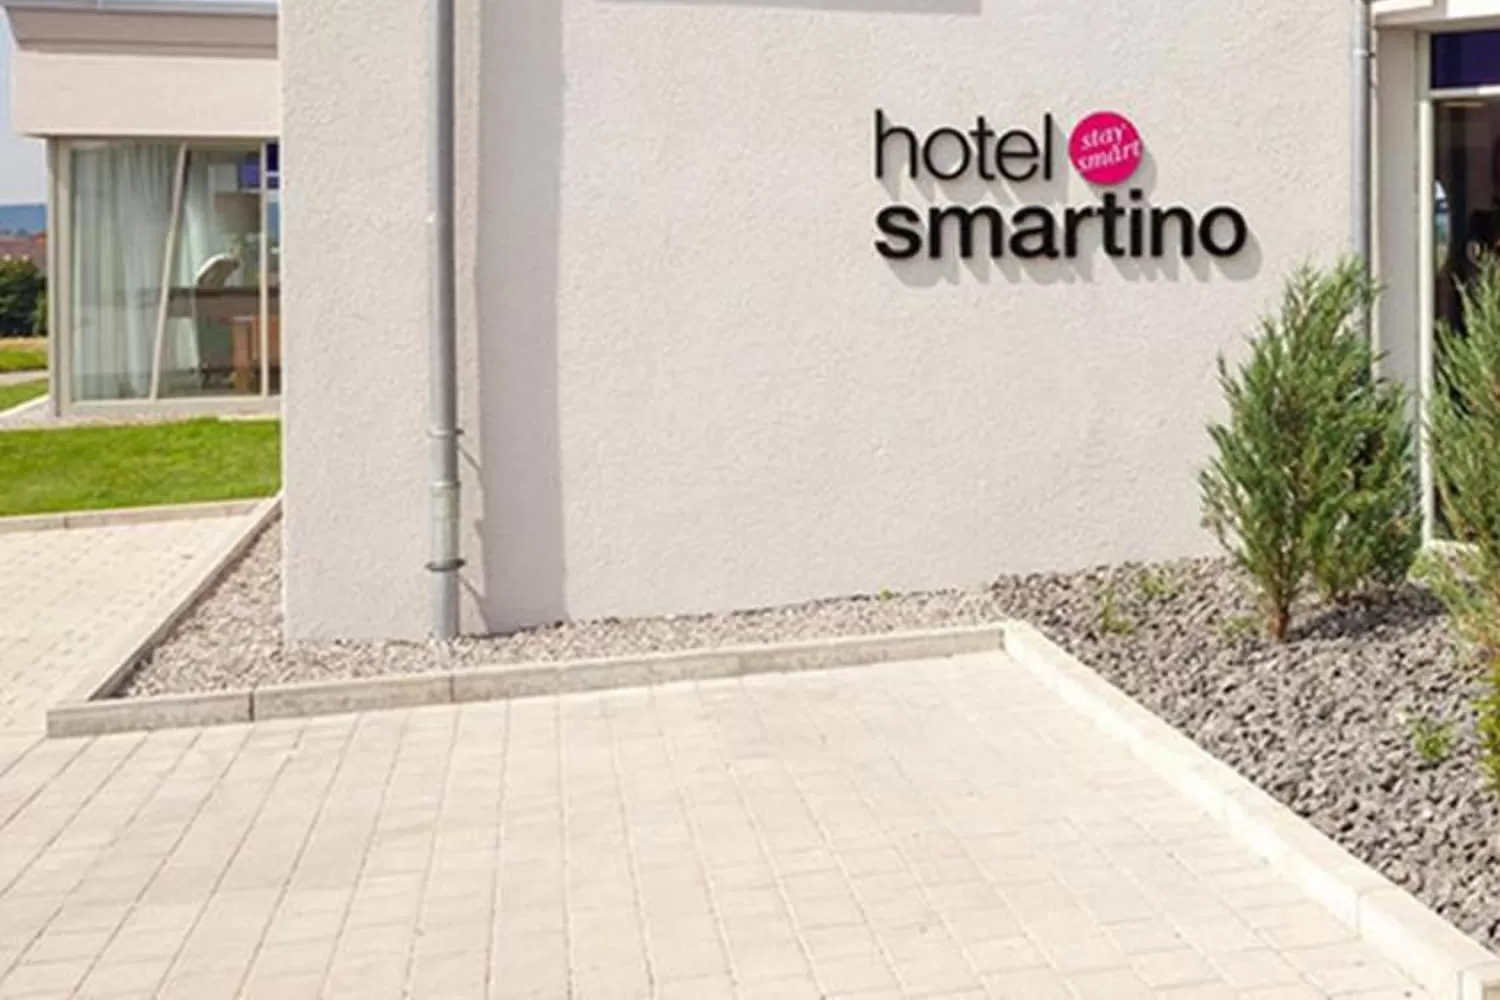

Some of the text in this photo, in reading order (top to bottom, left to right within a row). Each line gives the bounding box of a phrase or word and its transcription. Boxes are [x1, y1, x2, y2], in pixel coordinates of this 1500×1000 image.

[875, 109, 1051, 181] hotel
[1077, 139, 1141, 171] smart
[1081, 123, 1126, 151] stay
[874, 189, 1248, 259] smartino
